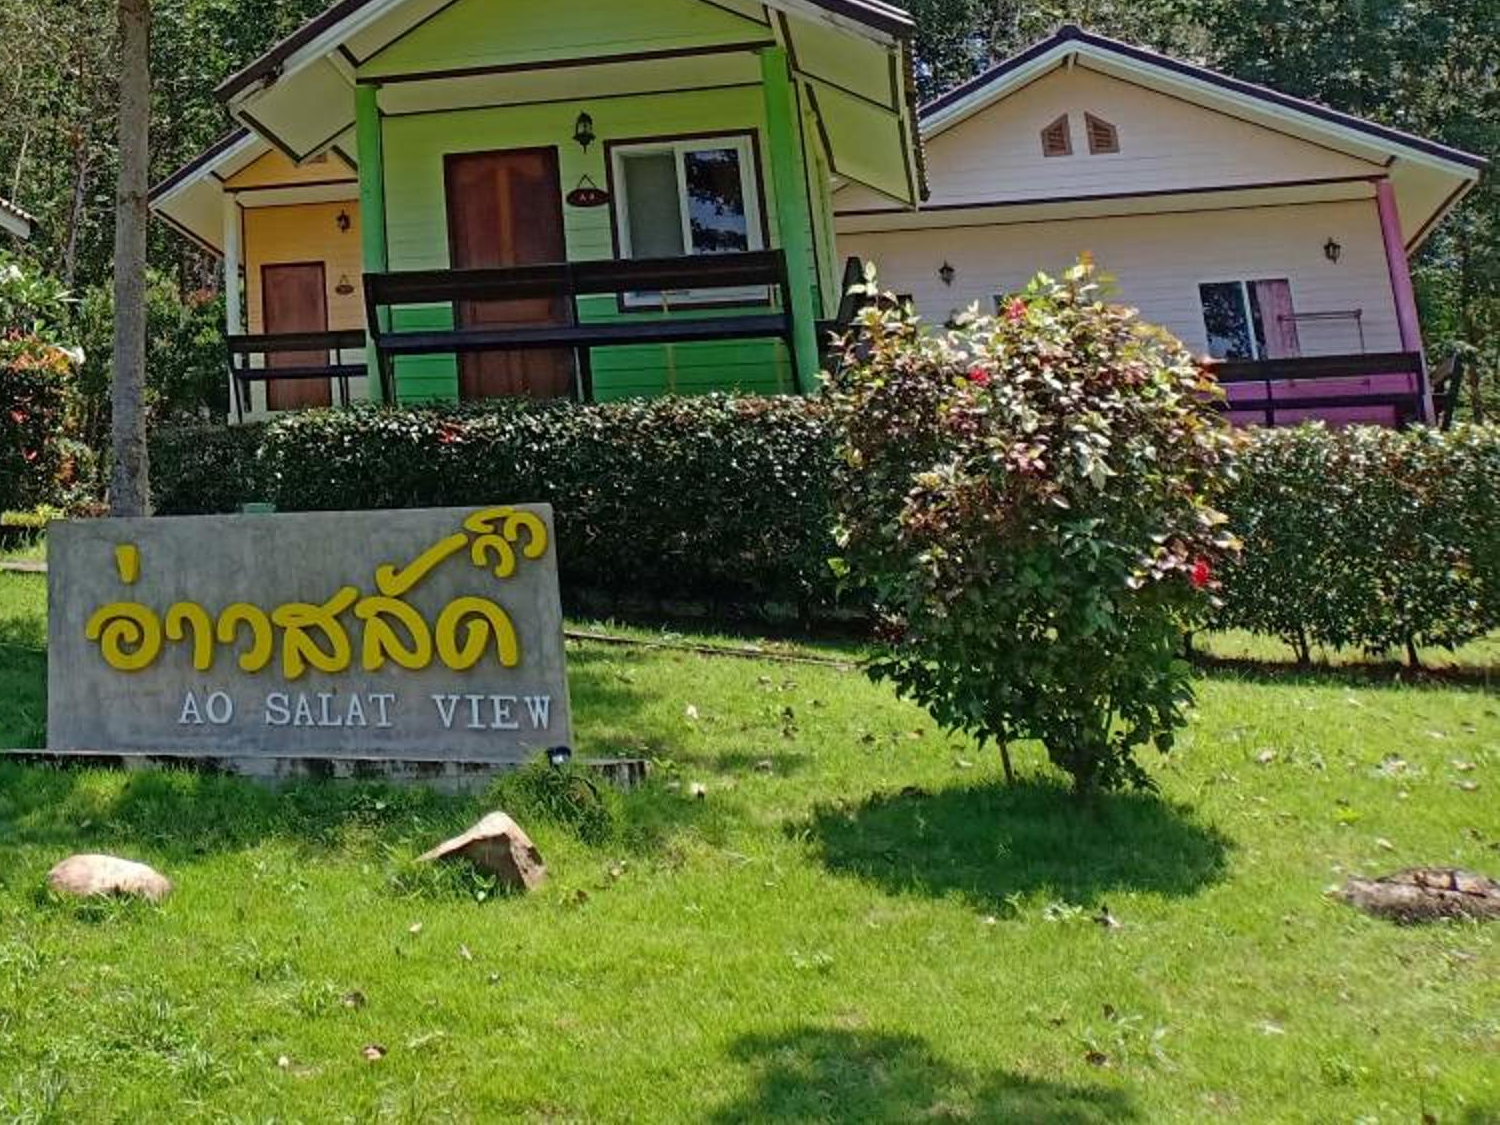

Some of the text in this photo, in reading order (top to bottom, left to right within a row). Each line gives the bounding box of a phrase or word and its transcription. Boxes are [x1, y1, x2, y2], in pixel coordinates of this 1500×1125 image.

[179, 691, 551, 729] AO SALAT VIEW
